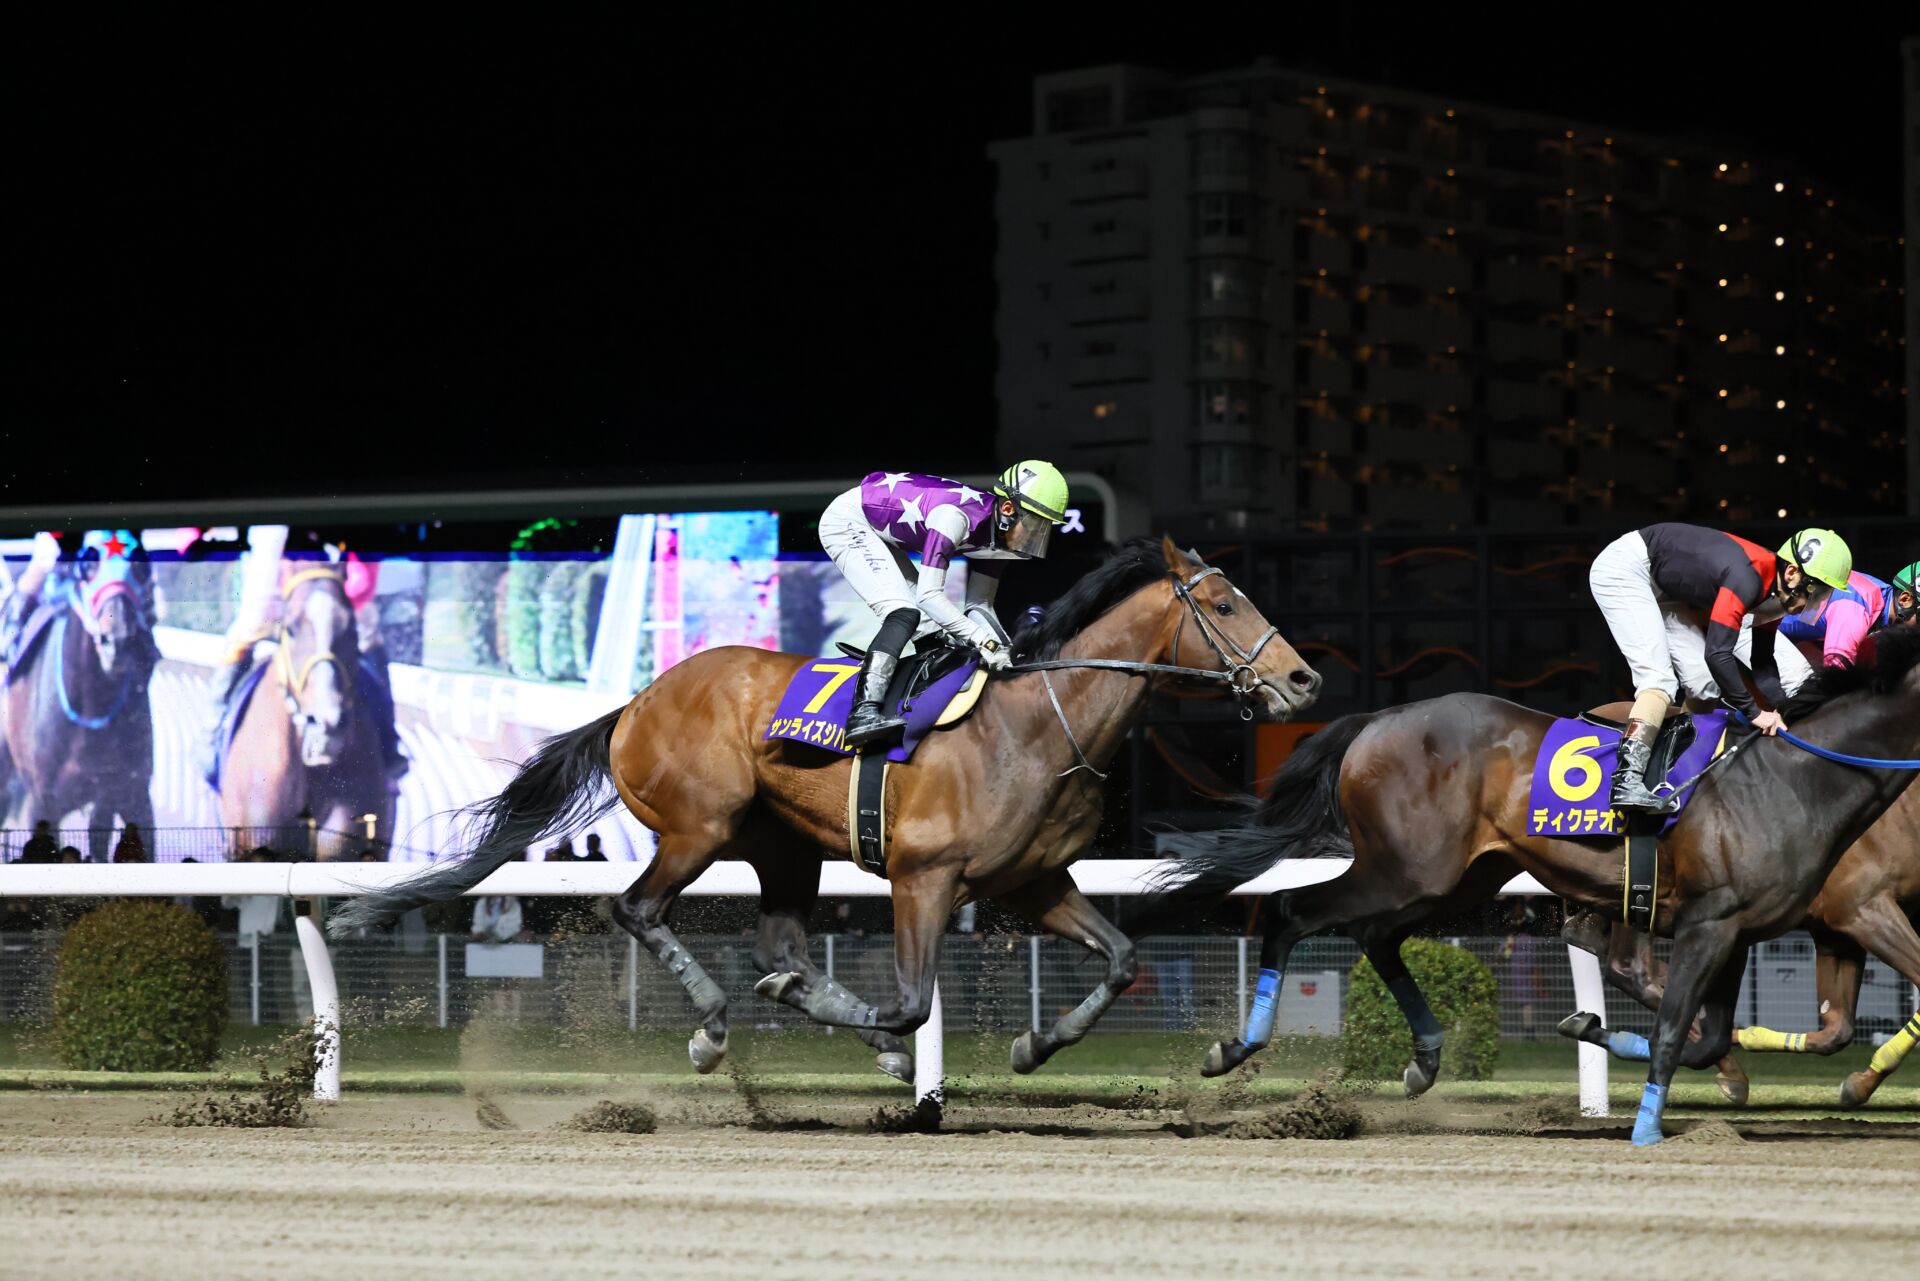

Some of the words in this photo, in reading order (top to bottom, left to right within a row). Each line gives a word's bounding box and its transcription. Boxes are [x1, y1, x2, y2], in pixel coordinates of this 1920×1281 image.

[1013, 468, 1037, 490] 7
[1799, 538, 1821, 564] 6
[803, 664, 862, 714] 7
[1549, 736, 1602, 802] 6
[1533, 808, 1628, 834] ディクテオン
